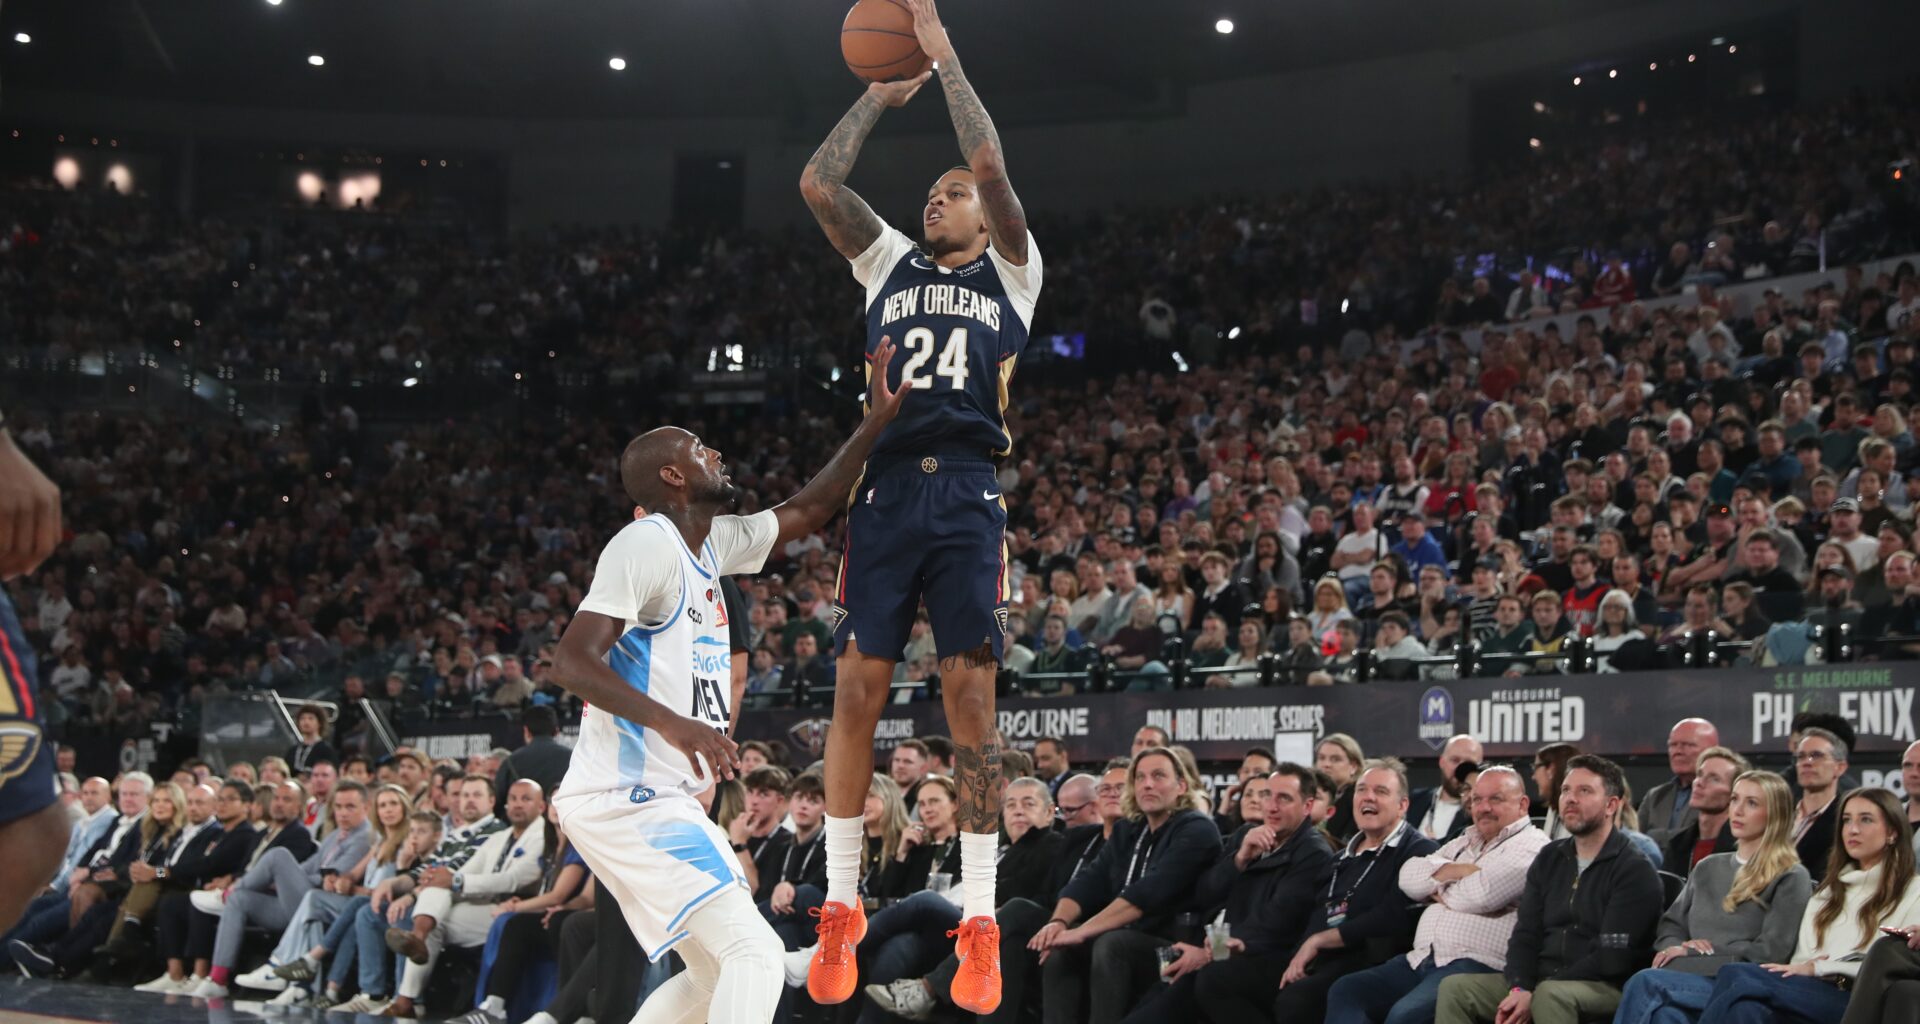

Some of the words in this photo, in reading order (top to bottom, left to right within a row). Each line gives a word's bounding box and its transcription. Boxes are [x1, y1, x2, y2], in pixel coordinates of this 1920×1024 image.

[881, 286, 920, 326] NEW
[923, 284, 1000, 331] ORLEANS
[902, 327, 969, 390] 24
[1492, 687, 1561, 701] MELBOURNE
[1775, 673, 1798, 689] S.E.
[1802, 669, 1893, 688] MELBOURNE
[997, 707, 1089, 738] BOURNE
[1202, 706, 1278, 741] MELBOURNE
[1469, 696, 1584, 743] UNITED
[1752, 688, 1916, 745] PHENIX
